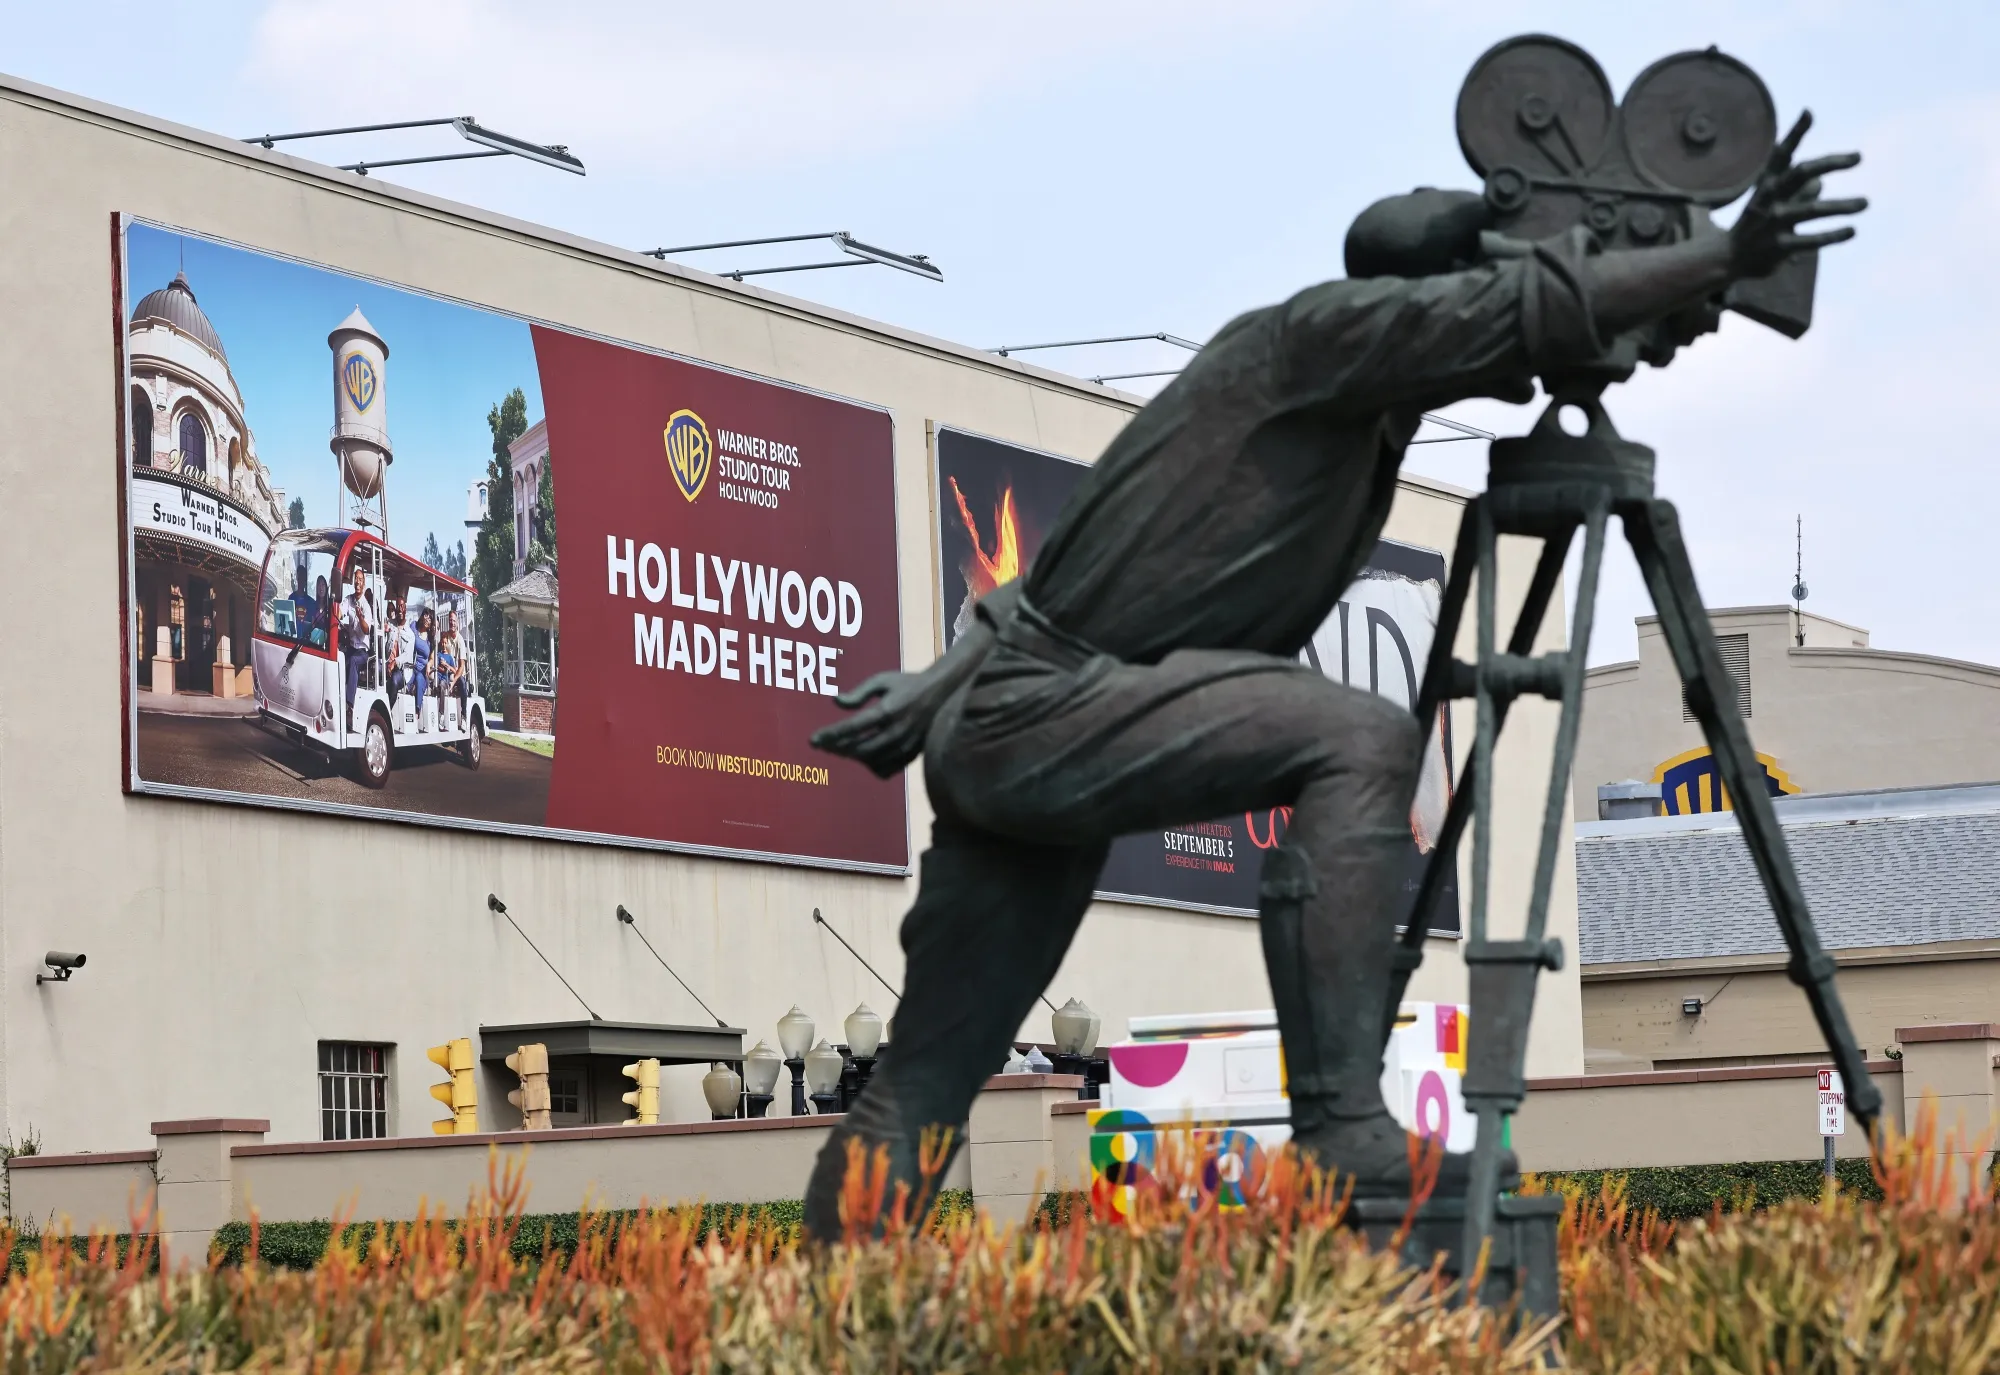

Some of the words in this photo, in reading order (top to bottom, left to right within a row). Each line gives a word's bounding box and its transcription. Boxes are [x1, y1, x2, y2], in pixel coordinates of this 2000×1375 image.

[717, 429, 767, 460] WARNER
[770, 441, 801, 468] BROS.
[719, 455, 759, 484] STUDIO
[761, 465, 790, 491] TOUR
[181, 487, 215, 516] WARNER
[719, 481, 778, 509] HOLLYWOOD
[153, 502, 186, 527] STUDIO
[189, 511, 212, 535] TOUR
[215, 520, 253, 553] HOLLYWOOD
[607, 534, 863, 637] HOLLYWOOD
[634, 612, 740, 681] MADE
[748, 632, 839, 697] HERE
[656, 745, 687, 767] BOOK
[689, 749, 715, 770] NOW
[716, 753, 829, 786] WBSTUDIOTOUR.COM
[1164, 831, 1226, 858] SEPTEMBER
[1227, 841, 1234, 858] 5
[1165, 854, 1200, 869] EXPERIENCE
[1213, 861, 1235, 873] IMAX
[1819, 1073, 1829, 1088] NO
[1820, 1092, 1843, 1105] STOPPING
[1826, 1106, 1837, 1116] ANY
[1826, 1118, 1837, 1128] TIME
